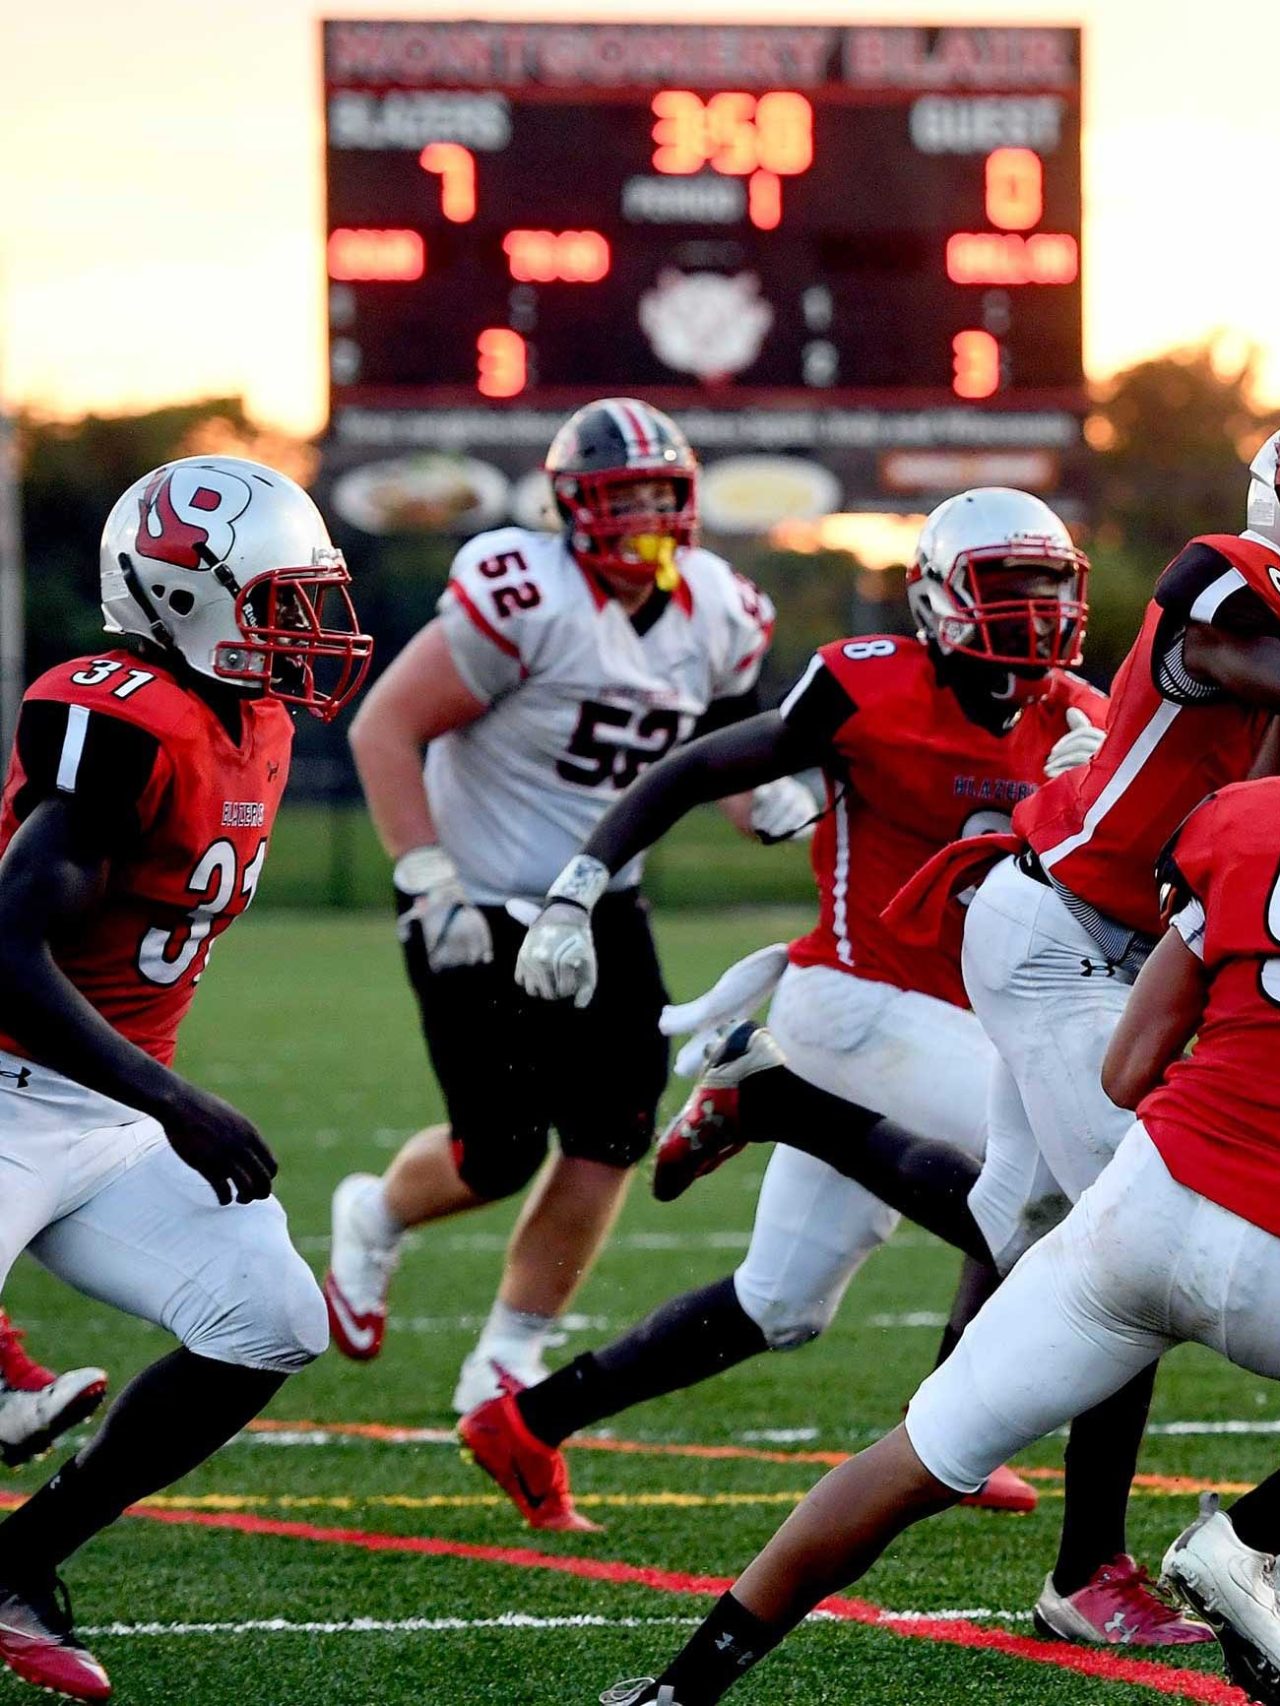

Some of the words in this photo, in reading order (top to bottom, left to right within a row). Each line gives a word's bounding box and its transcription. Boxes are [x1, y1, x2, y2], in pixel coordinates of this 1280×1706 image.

[479, 550, 541, 618] 52
[843, 639, 896, 660] 8
[71, 659, 155, 699] 31
[221, 801, 264, 827] BLAZERS
